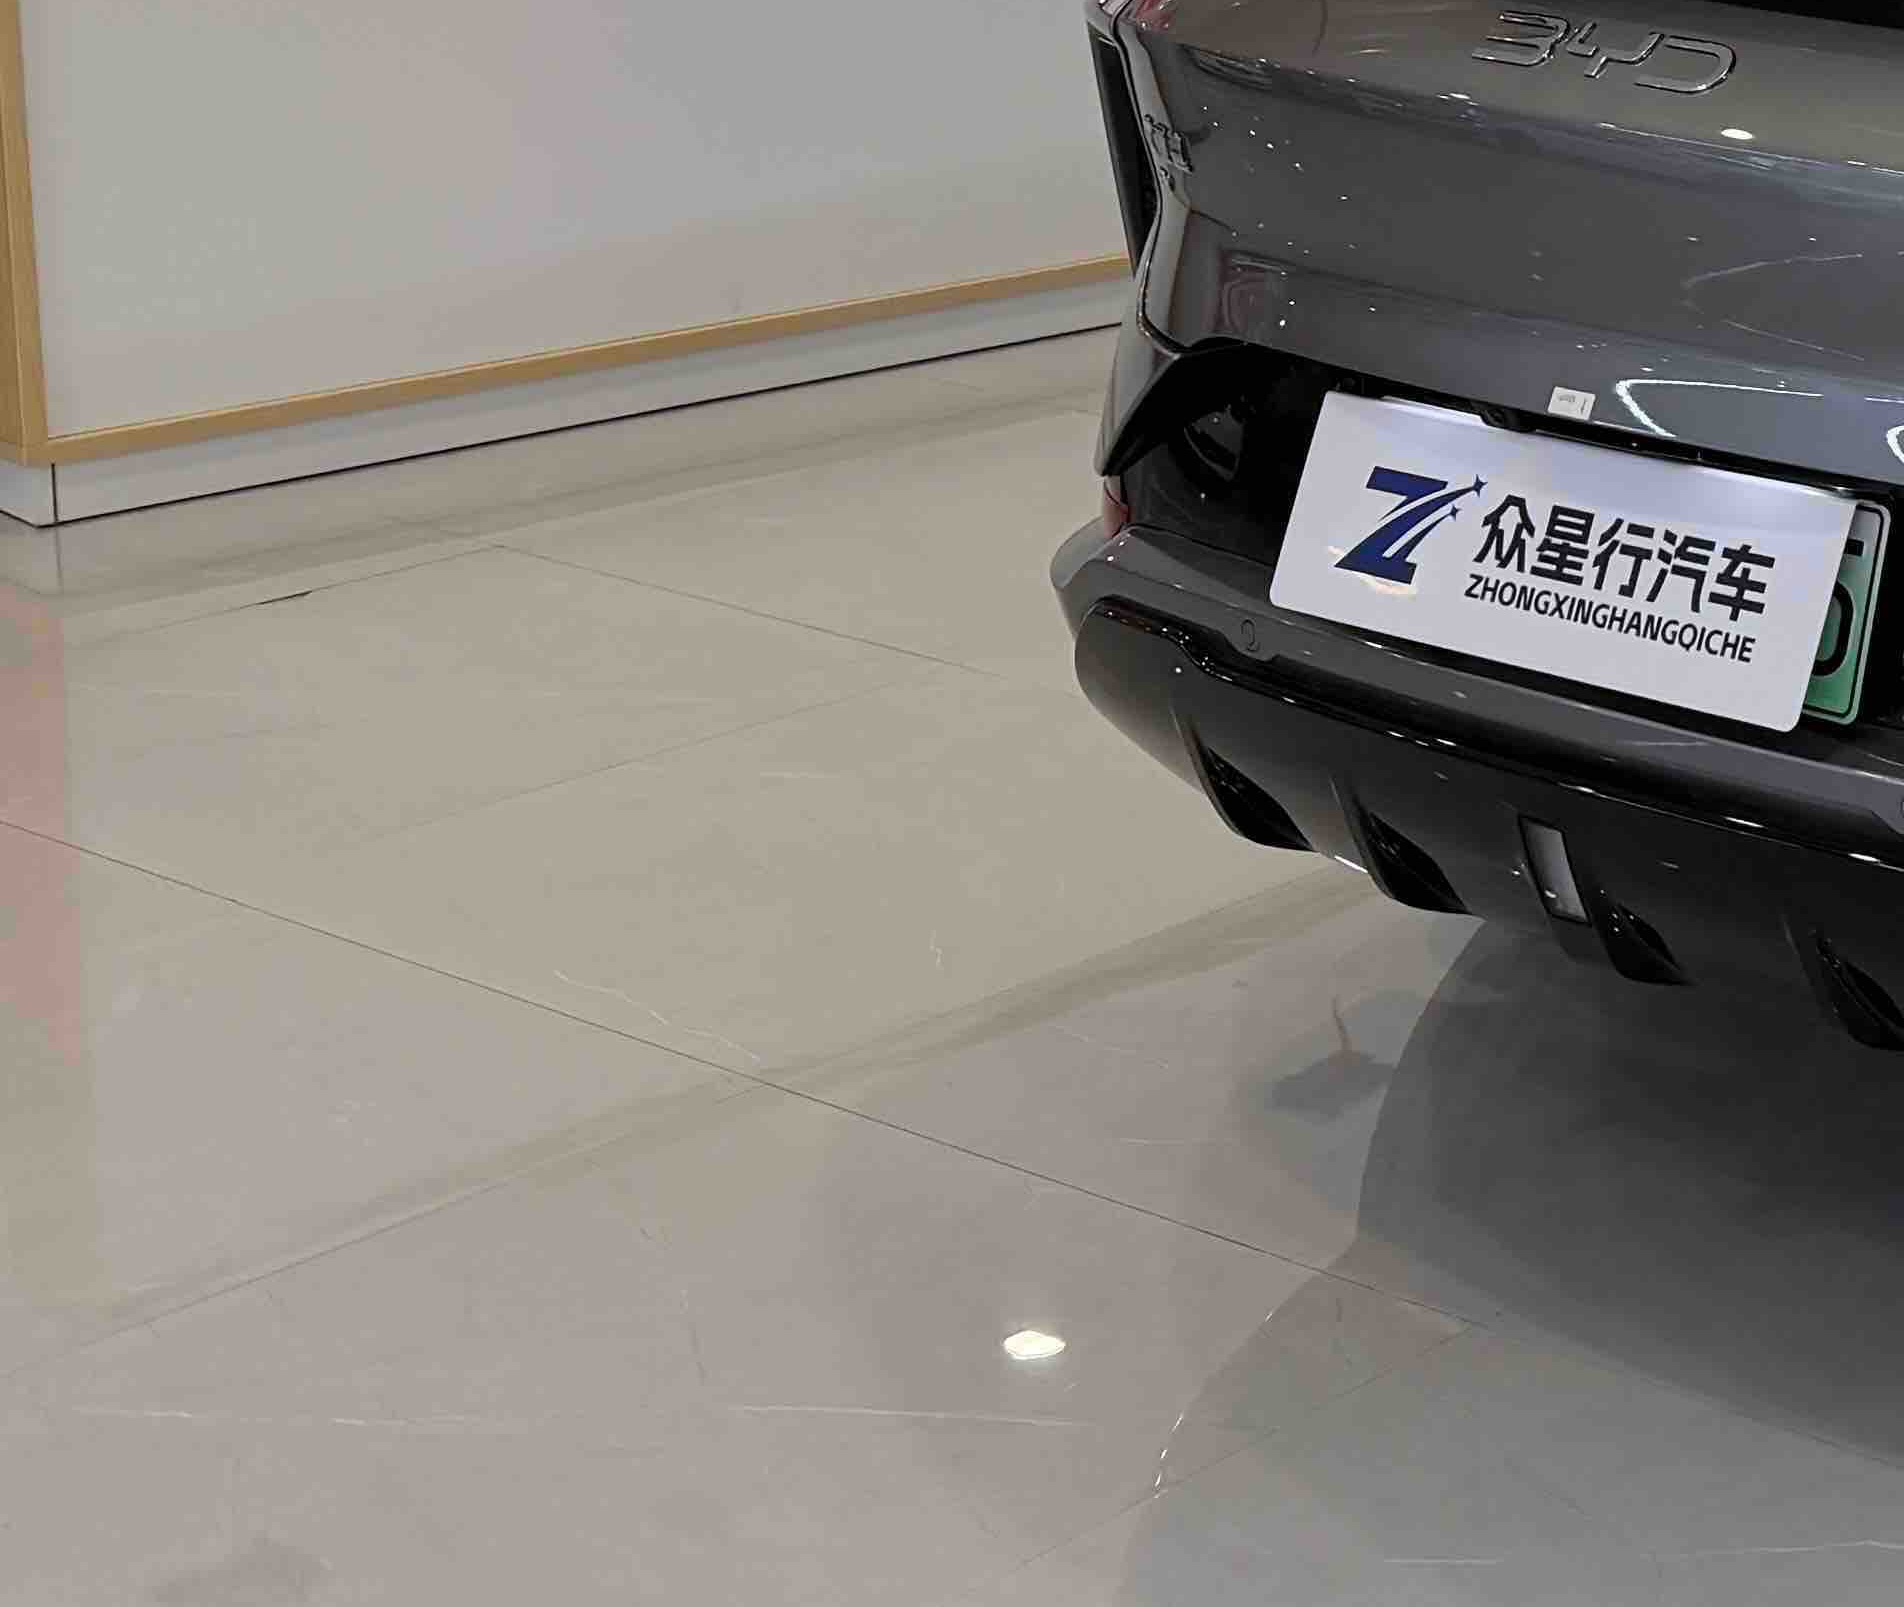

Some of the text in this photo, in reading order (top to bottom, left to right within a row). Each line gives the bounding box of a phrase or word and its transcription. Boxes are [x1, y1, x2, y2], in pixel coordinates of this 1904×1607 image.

[1471, 9, 1737, 95] BYD
[1473, 493, 1777, 623] 众星行汽车
[1463, 573, 1758, 664] ZHONGXINGHANGQICHE
